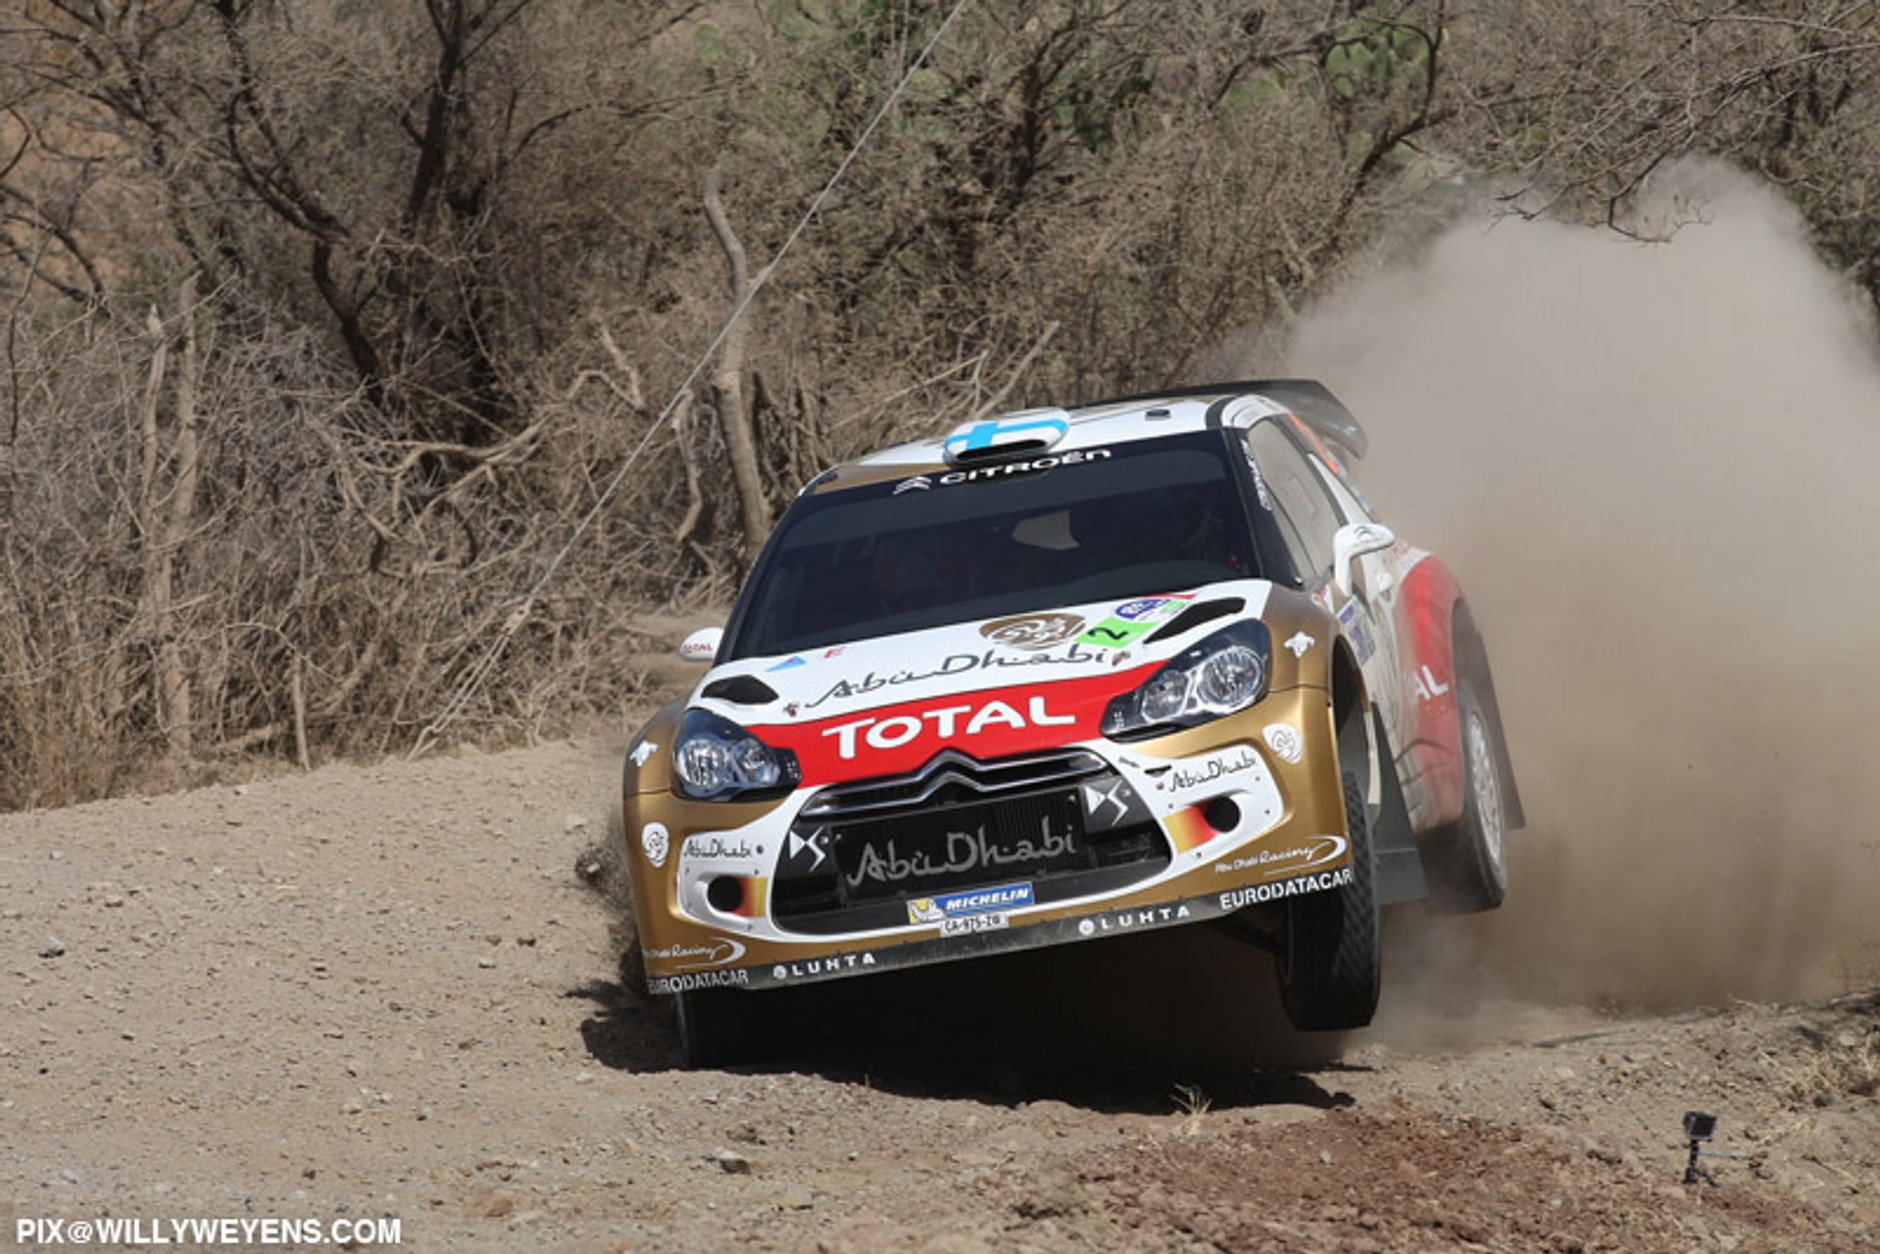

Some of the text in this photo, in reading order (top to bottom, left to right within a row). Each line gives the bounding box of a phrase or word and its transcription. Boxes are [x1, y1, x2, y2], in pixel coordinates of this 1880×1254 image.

[1087, 627, 1129, 641] 2
[822, 696, 1076, 760] TOTAL
[946, 887, 1029, 911] MICHELIN
[1219, 868, 1354, 911] EURODATACAR
[1101, 905, 1191, 930] LUHTA
[791, 952, 876, 977] LUHTA
